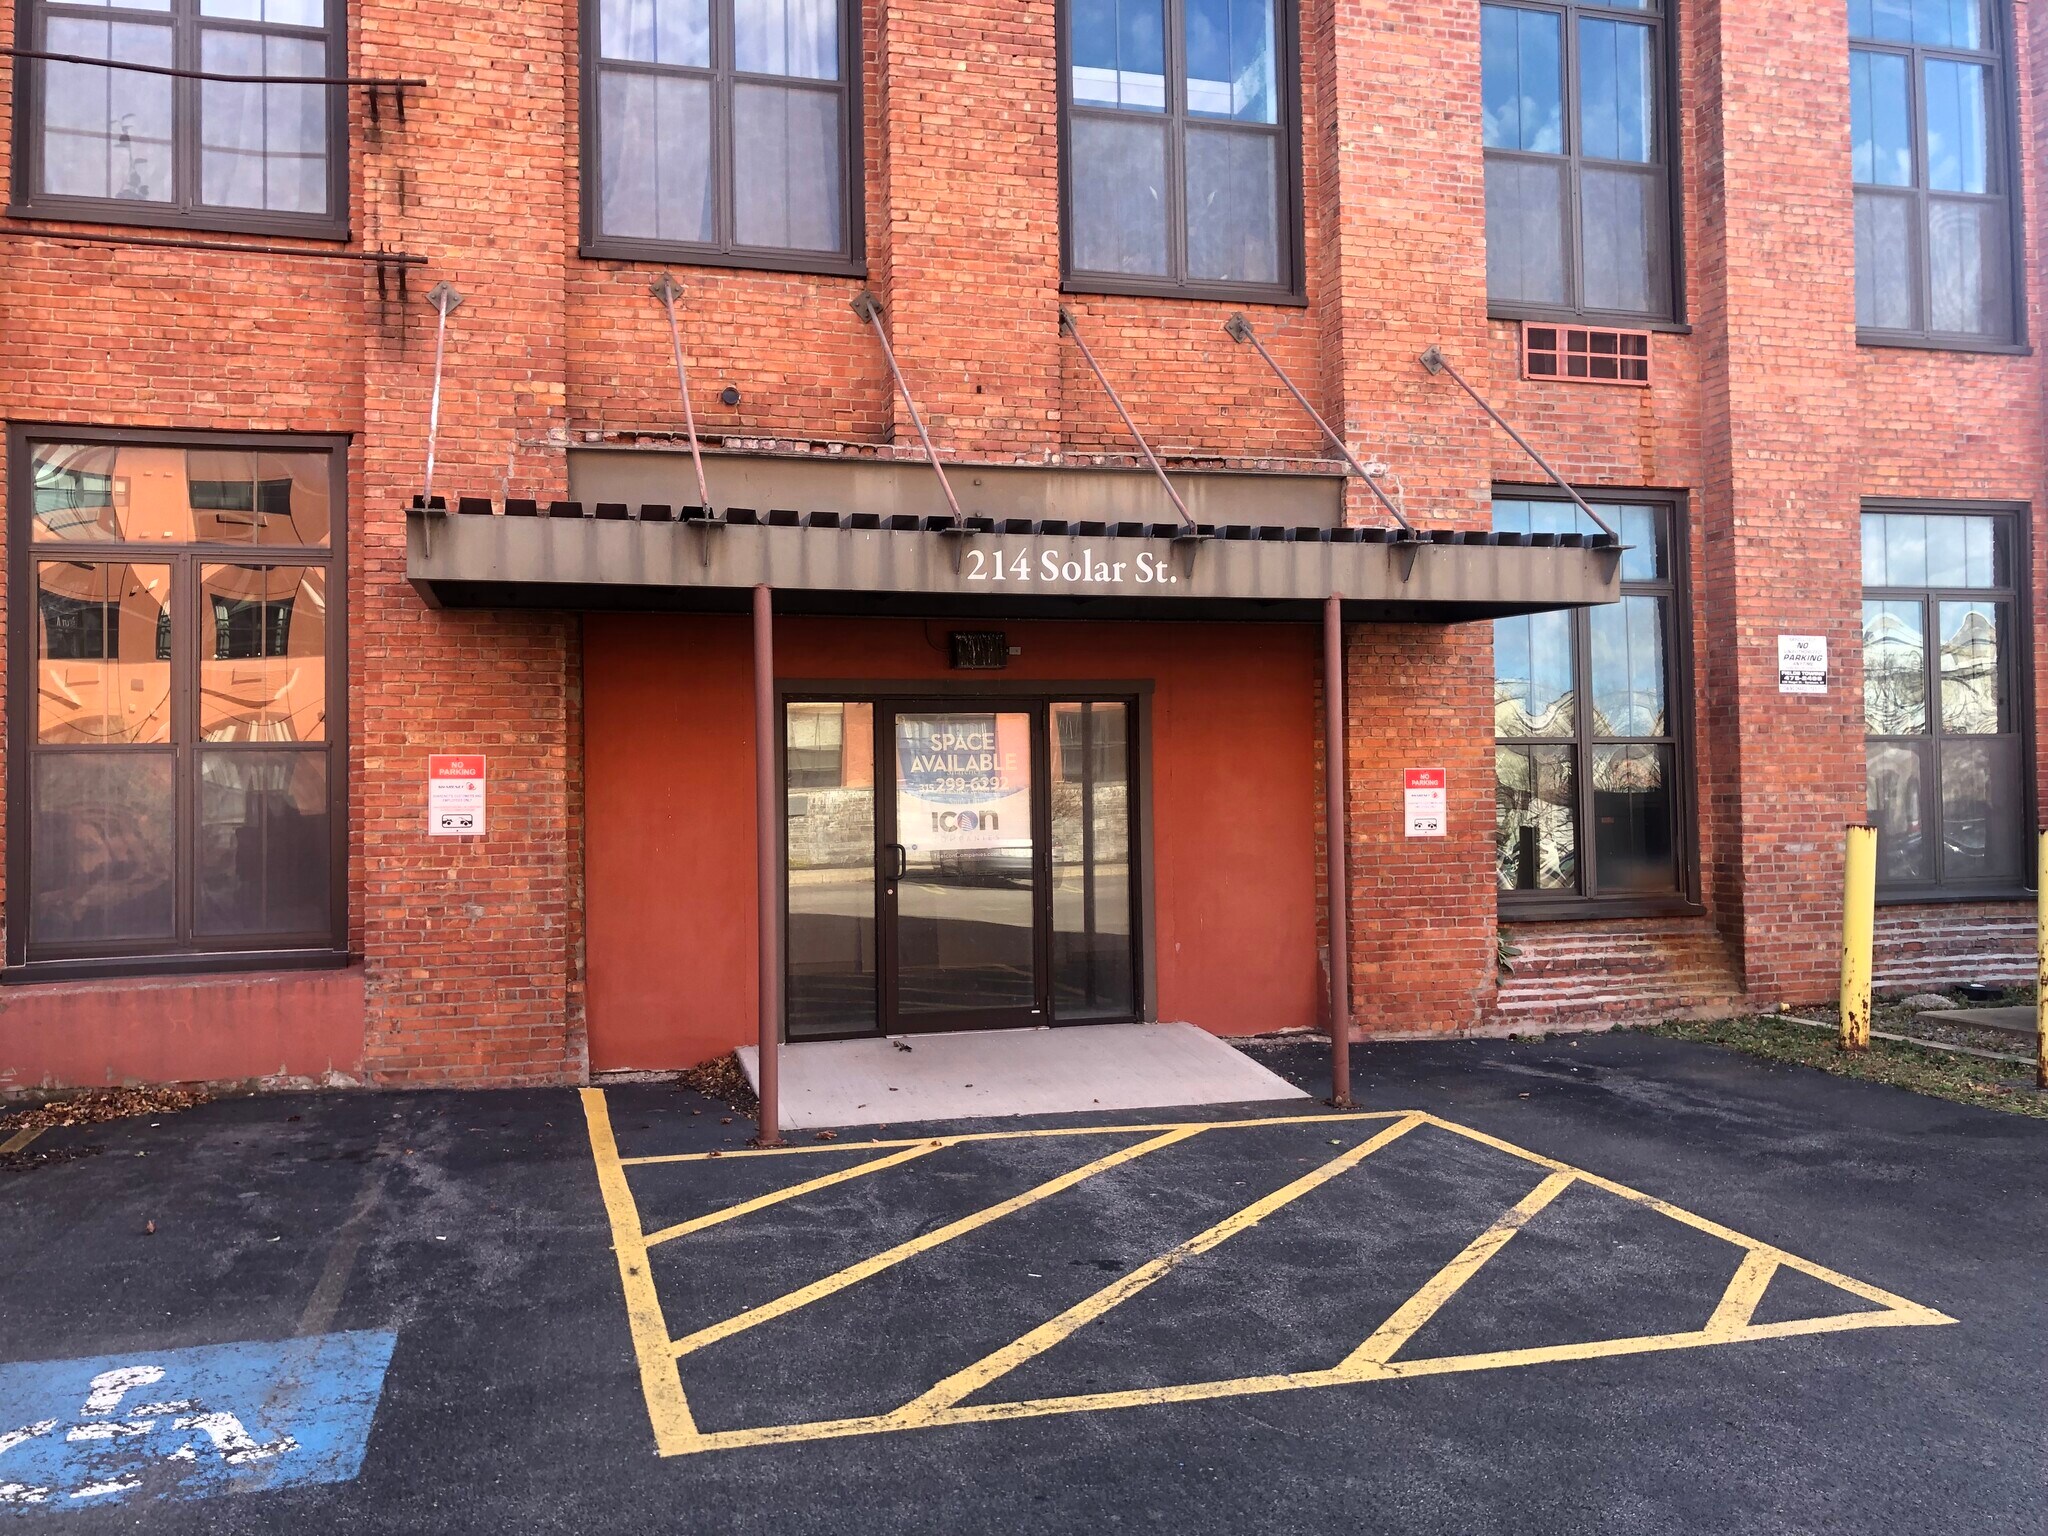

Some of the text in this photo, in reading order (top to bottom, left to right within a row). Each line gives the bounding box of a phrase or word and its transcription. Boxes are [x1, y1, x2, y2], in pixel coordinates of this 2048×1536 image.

[966, 547, 1178, 584] 214 Solar St.
[931, 732, 995, 751] SPACE
[910, 753, 1017, 773] AVAILABLE
